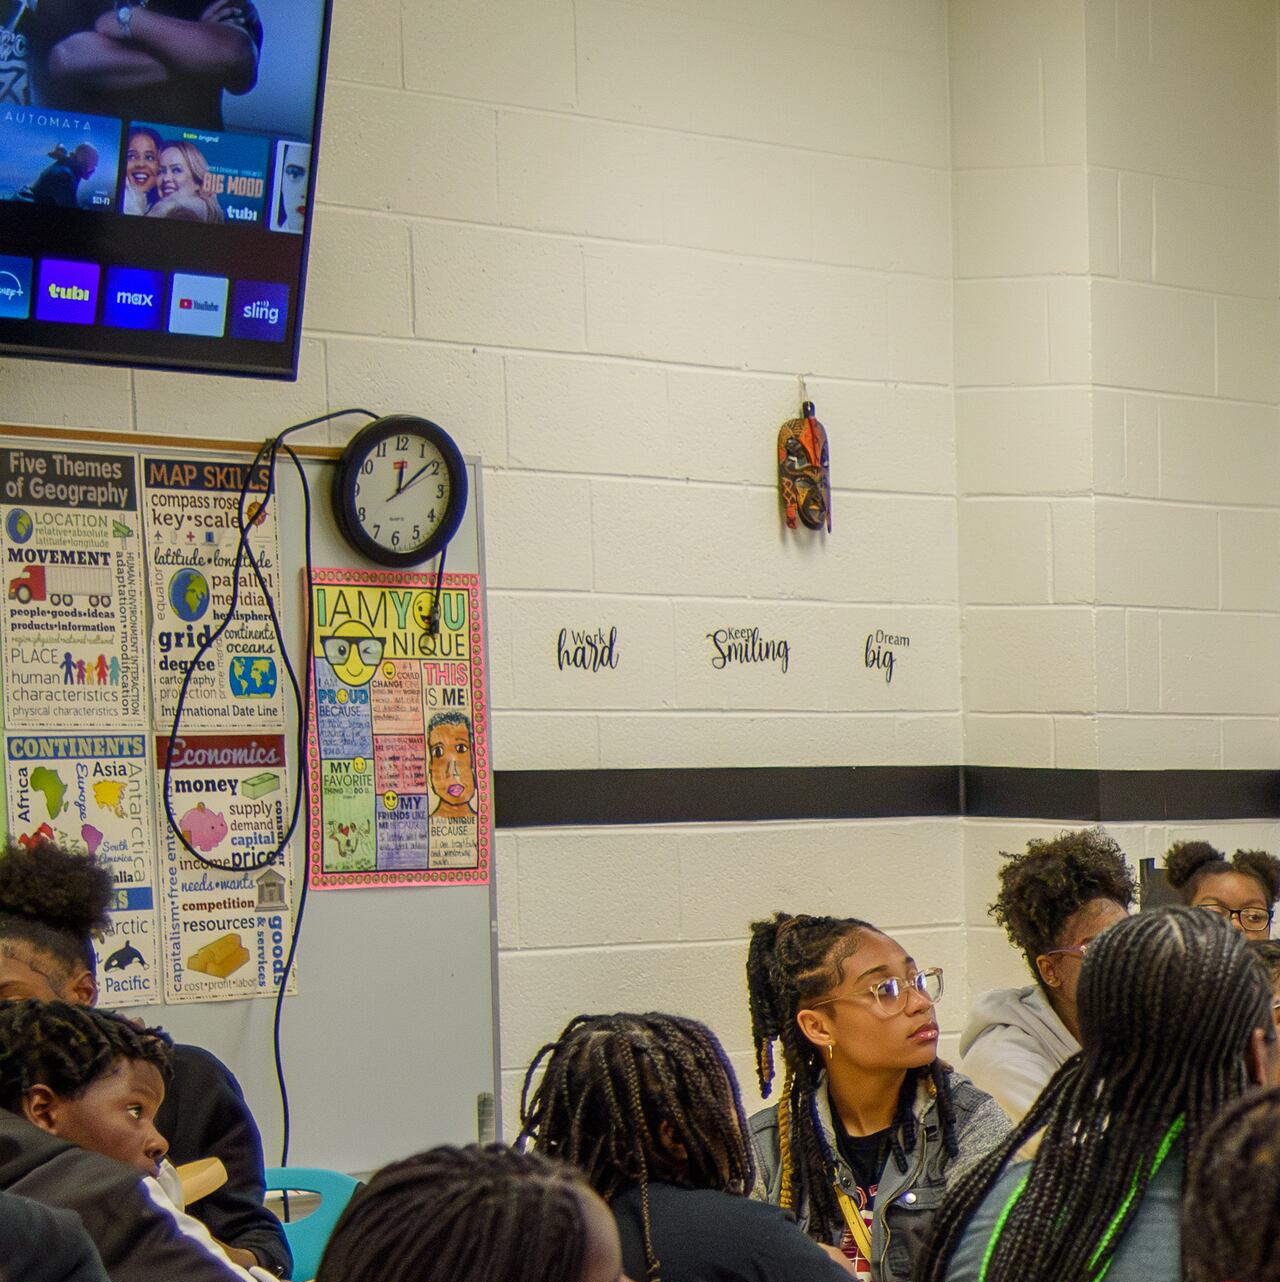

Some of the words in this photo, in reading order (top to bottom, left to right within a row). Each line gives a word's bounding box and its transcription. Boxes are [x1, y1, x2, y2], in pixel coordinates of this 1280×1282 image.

[5, 111, 92, 131] AUTOMATA
[203, 172, 225, 194] BIG
[227, 175, 264, 199] MOOD
[227, 205, 258, 221] tubi
[49, 283, 90, 301] tubi
[116, 291, 154, 307] max
[243, 300, 280, 324] sling
[9, 451, 48, 476] Five
[51, 453, 123, 480] Themes
[149, 462, 198, 487] MAP
[5, 476, 26, 499] of
[29, 477, 129, 509] Geography
[151, 493, 211, 512] compass
[212, 496, 241, 510] rose
[34, 511, 109, 529] LOCATION
[151, 508, 185, 531] key
[194, 511, 241, 529] scale
[8, 547, 112, 567] MOVEMENT
[153, 546, 206, 566] latitude
[154, 566, 167, 621] equator
[316, 588, 328, 628] I
[158, 624, 214, 653] grid
[223, 622, 276, 641] continents
[571, 628, 607, 647] Work
[727, 626, 754, 642] Keep
[874, 629, 911, 648] Dream
[226, 642, 276, 654] oceans
[392, 631, 466, 657] NIQUE
[557, 626, 620, 674] hard
[705, 626, 791, 675] Smiling
[11, 648, 59, 665] PLACE
[864, 634, 897, 684] big
[11, 670, 61, 686] human
[423, 662, 469, 687] THIS
[371, 680, 403, 689] CHANGE
[12, 687, 119, 703] characteristics
[317, 688, 369, 705] PROUD
[425, 687, 438, 707] IS
[442, 688, 470, 706] ME!
[12, 705, 50, 719] physical
[53, 705, 119, 718] characteristics
[232, 704, 256, 718] Date
[257, 704, 279, 717] Line
[10, 736, 144, 759] CONTINENTS
[170, 737, 281, 768] Economics
[92, 760, 128, 777] Asia
[330, 762, 351, 774] MY
[174, 777, 240, 797] money
[323, 774, 373, 787] FAVORITE
[17, 766, 31, 823] Africa
[73, 762, 89, 822] Europe
[229, 800, 274, 819] supply
[400, 796, 422, 810] MY
[127, 762, 147, 883] Antarctica
[230, 818, 275, 832] demand
[377, 811, 410, 821] FRIENDS
[448, 816, 476, 825] UNIQUE
[102, 839, 130, 854] South
[230, 831, 276, 848] capital
[231, 846, 278, 872] price
[168, 865, 179, 898] free
[181, 872, 216, 893] needs
[220, 872, 257, 890] wants
[182, 897, 256, 913] competition
[183, 916, 256, 933] resources
[169, 905, 185, 993] capitalism
[268, 915, 286, 987] goods
[256, 930, 268, 988] services
[105, 976, 151, 993] Pacific
